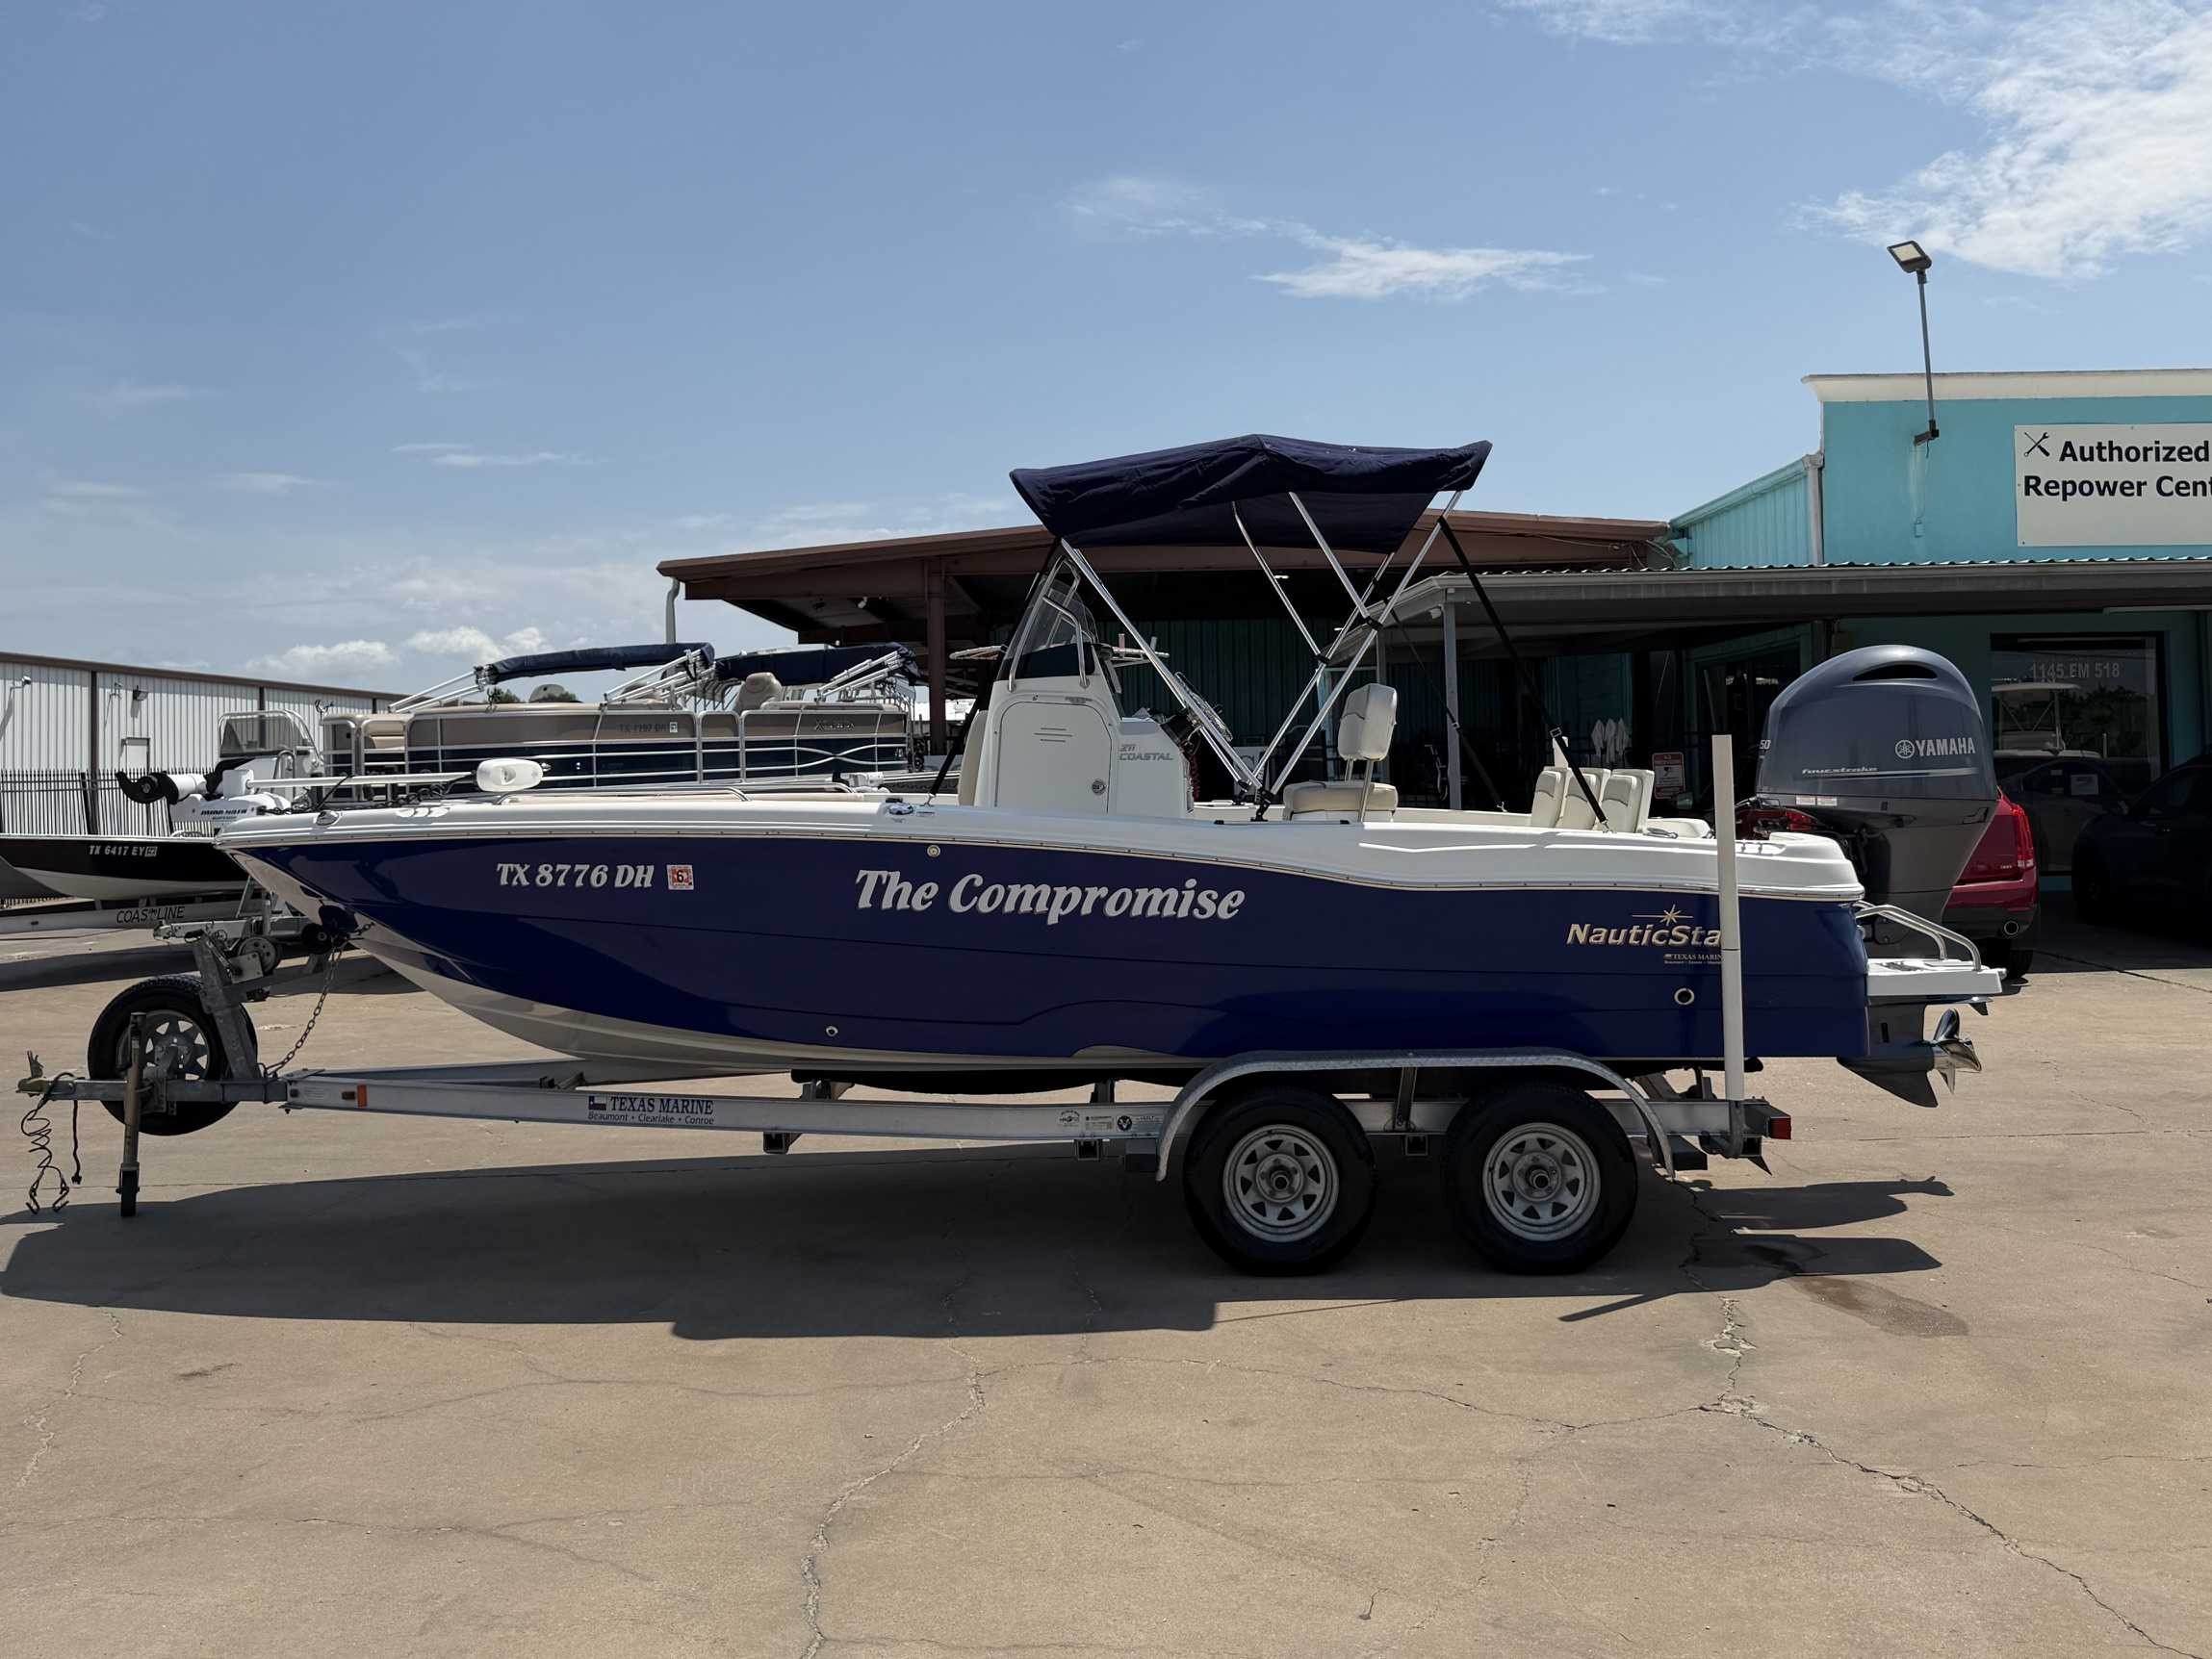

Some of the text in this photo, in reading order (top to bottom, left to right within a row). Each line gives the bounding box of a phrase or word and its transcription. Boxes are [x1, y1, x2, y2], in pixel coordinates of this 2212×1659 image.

[2059, 440, 2210, 463] Authorized
[2023, 474, 2212, 501] Repower Cen
[2031, 662, 2065, 678] 1145
[2095, 661, 2121, 678] 518
[1915, 737, 1976, 756] YAMAHA
[1119, 753, 1173, 761] COASTAL
[89, 845, 100, 855] TX
[104, 845, 128, 856] 6417
[131, 846, 144, 856] EY
[497, 863, 655, 888] TX 8776 DH
[855, 869, 1246, 926] The Compromise
[610, 1096, 714, 1115] TEXAS MARINE
[588, 1110, 714, 1126] Beaumont Clearlake Conroe
